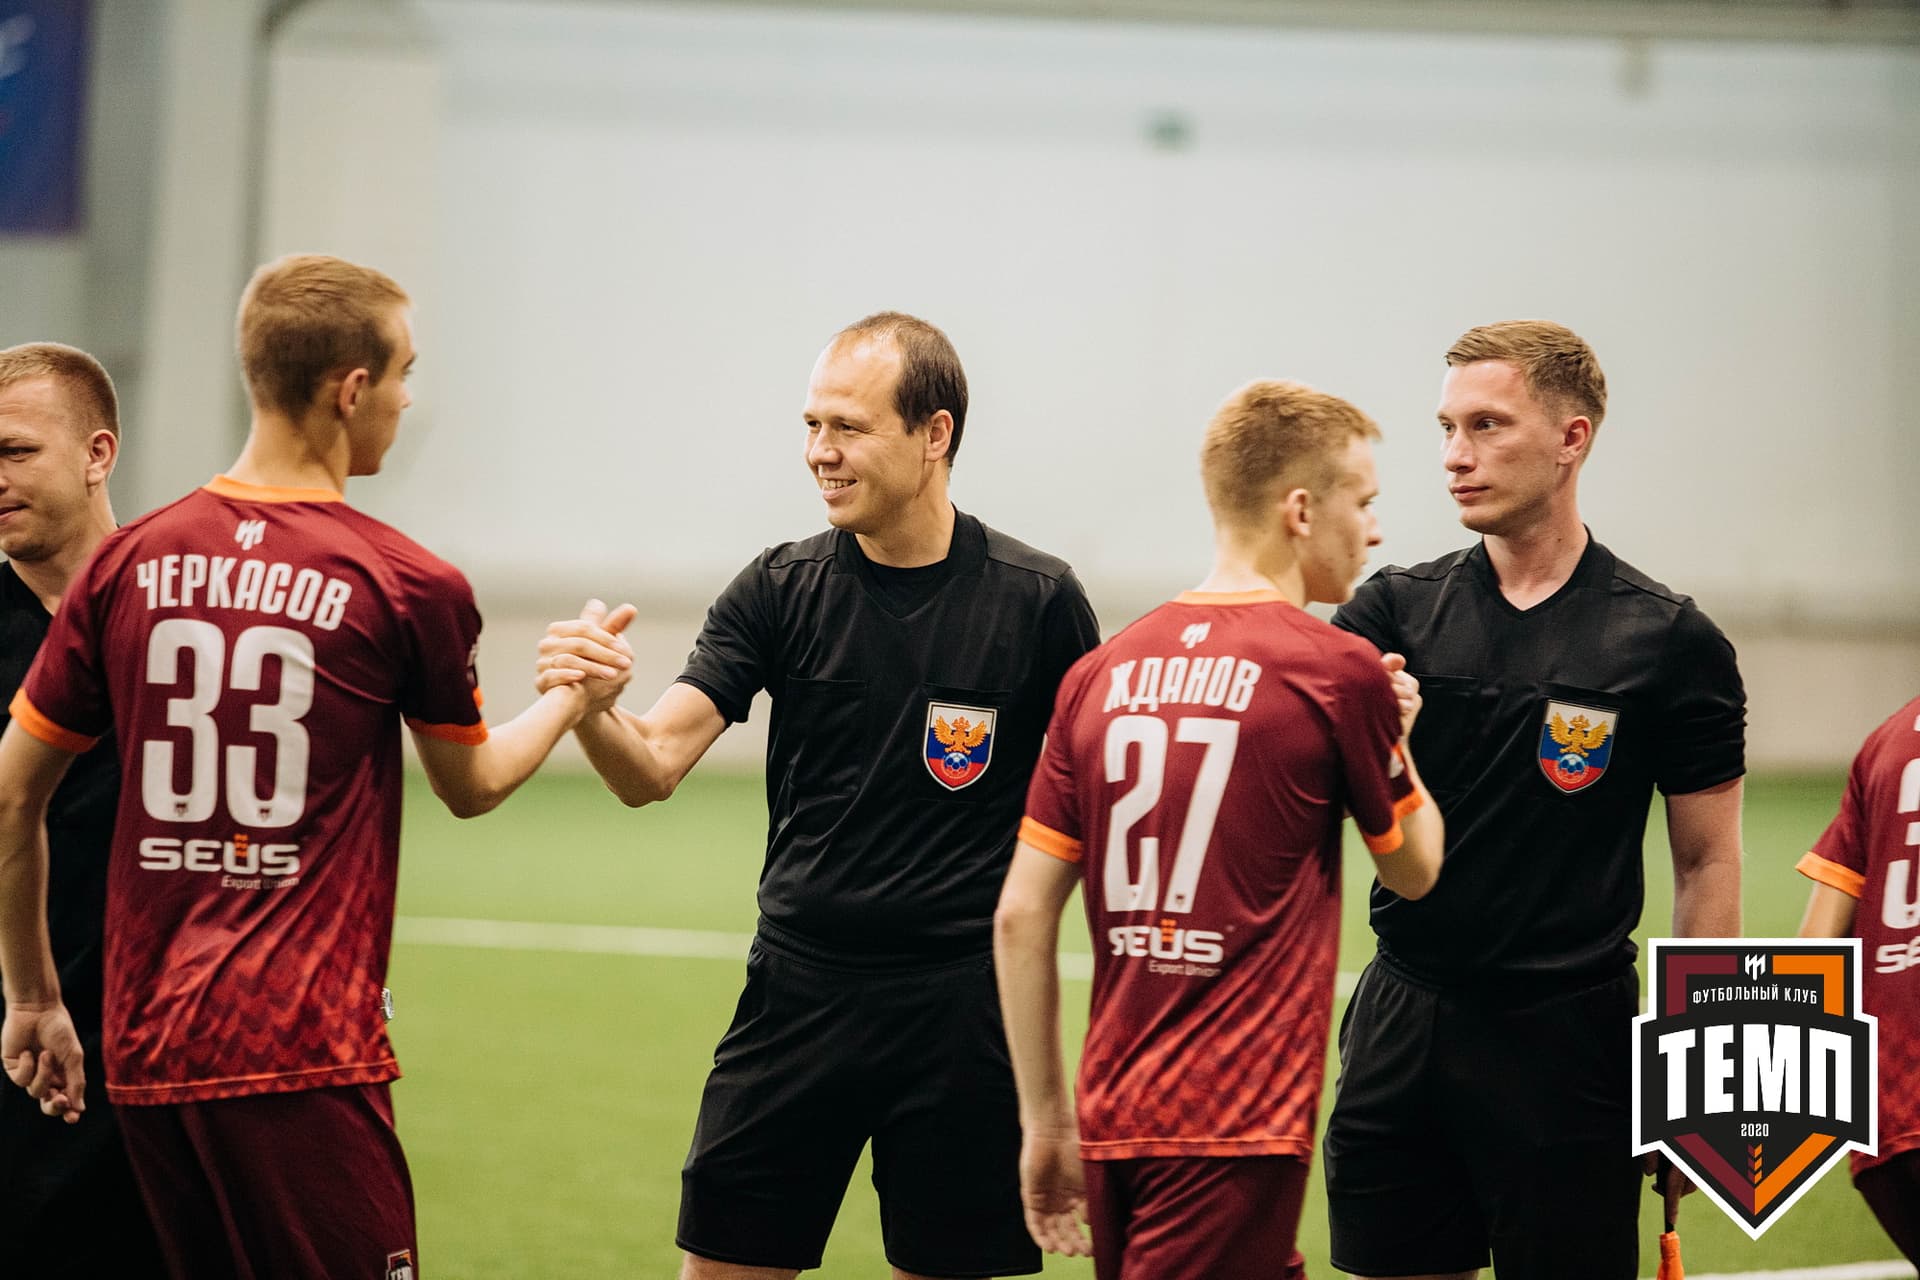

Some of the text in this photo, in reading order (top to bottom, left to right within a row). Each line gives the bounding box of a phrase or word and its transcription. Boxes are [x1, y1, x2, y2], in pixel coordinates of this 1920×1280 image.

[137, 554, 353, 631] ЧЕРКАСОВ
[142, 618, 315, 828] 33
[1103, 655, 1262, 713] ЖДАНОВ
[1103, 714, 1240, 914] 27
